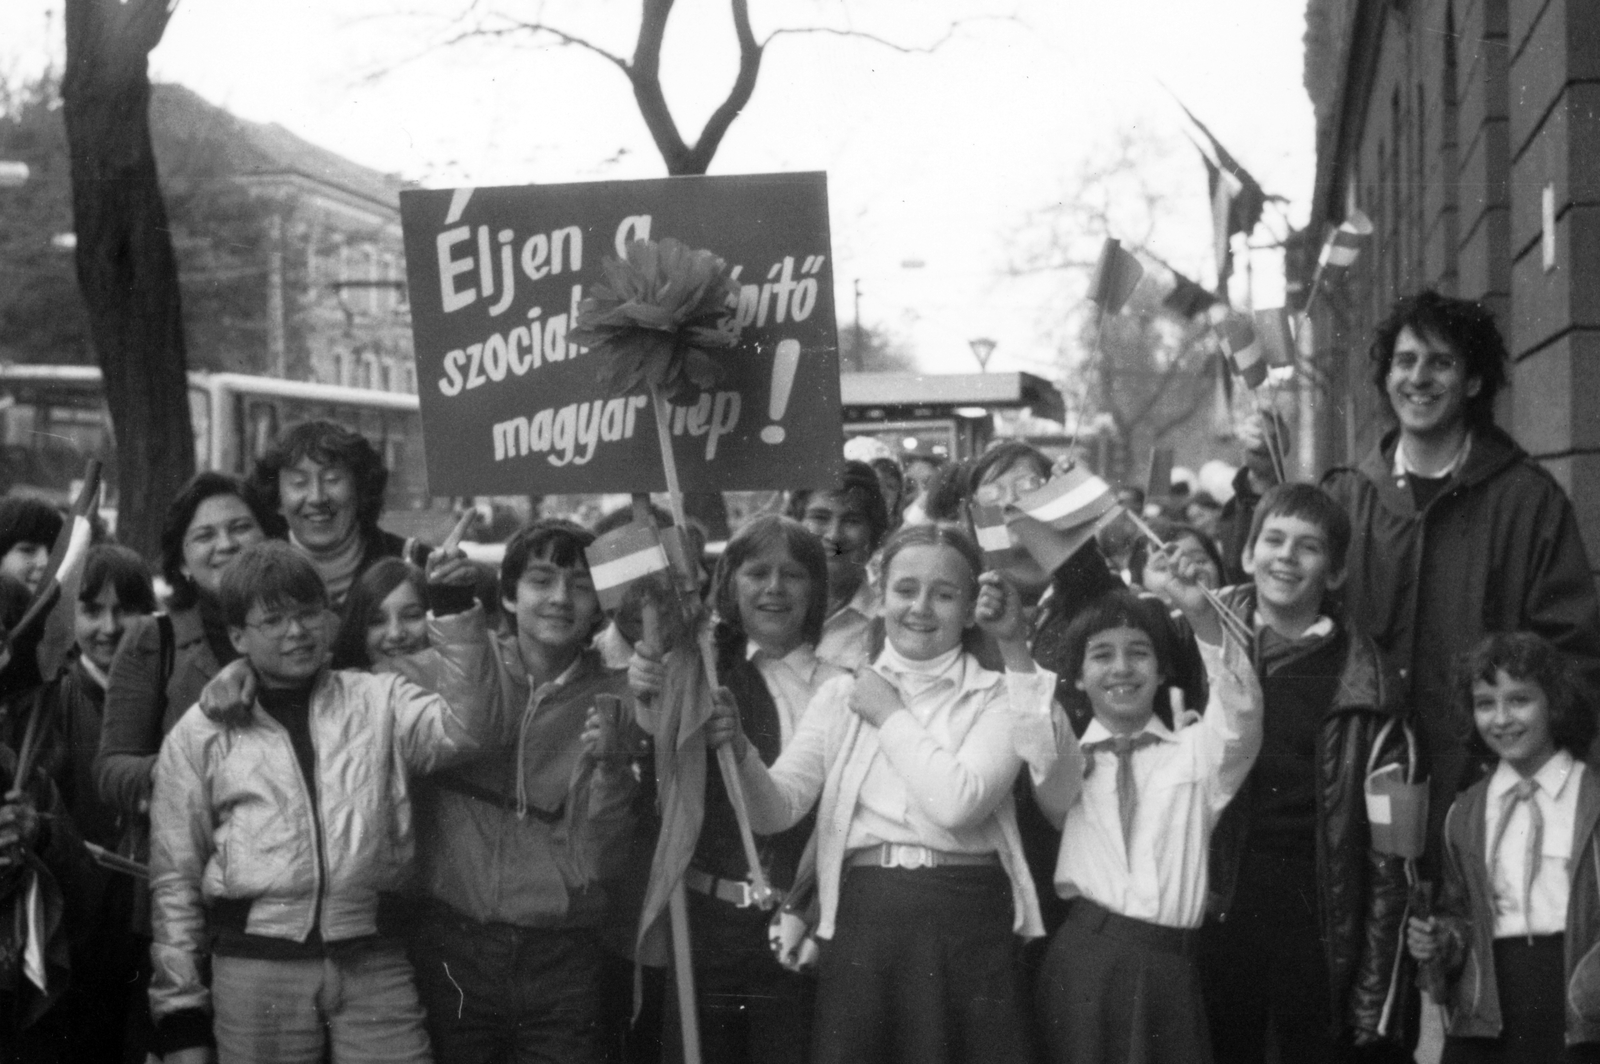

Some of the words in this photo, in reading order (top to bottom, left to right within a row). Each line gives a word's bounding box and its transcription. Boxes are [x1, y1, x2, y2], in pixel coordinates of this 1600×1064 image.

[436, 188, 583, 316] Éljen
[438, 284, 589, 397] szocial
[493, 395, 647, 467] magyar
